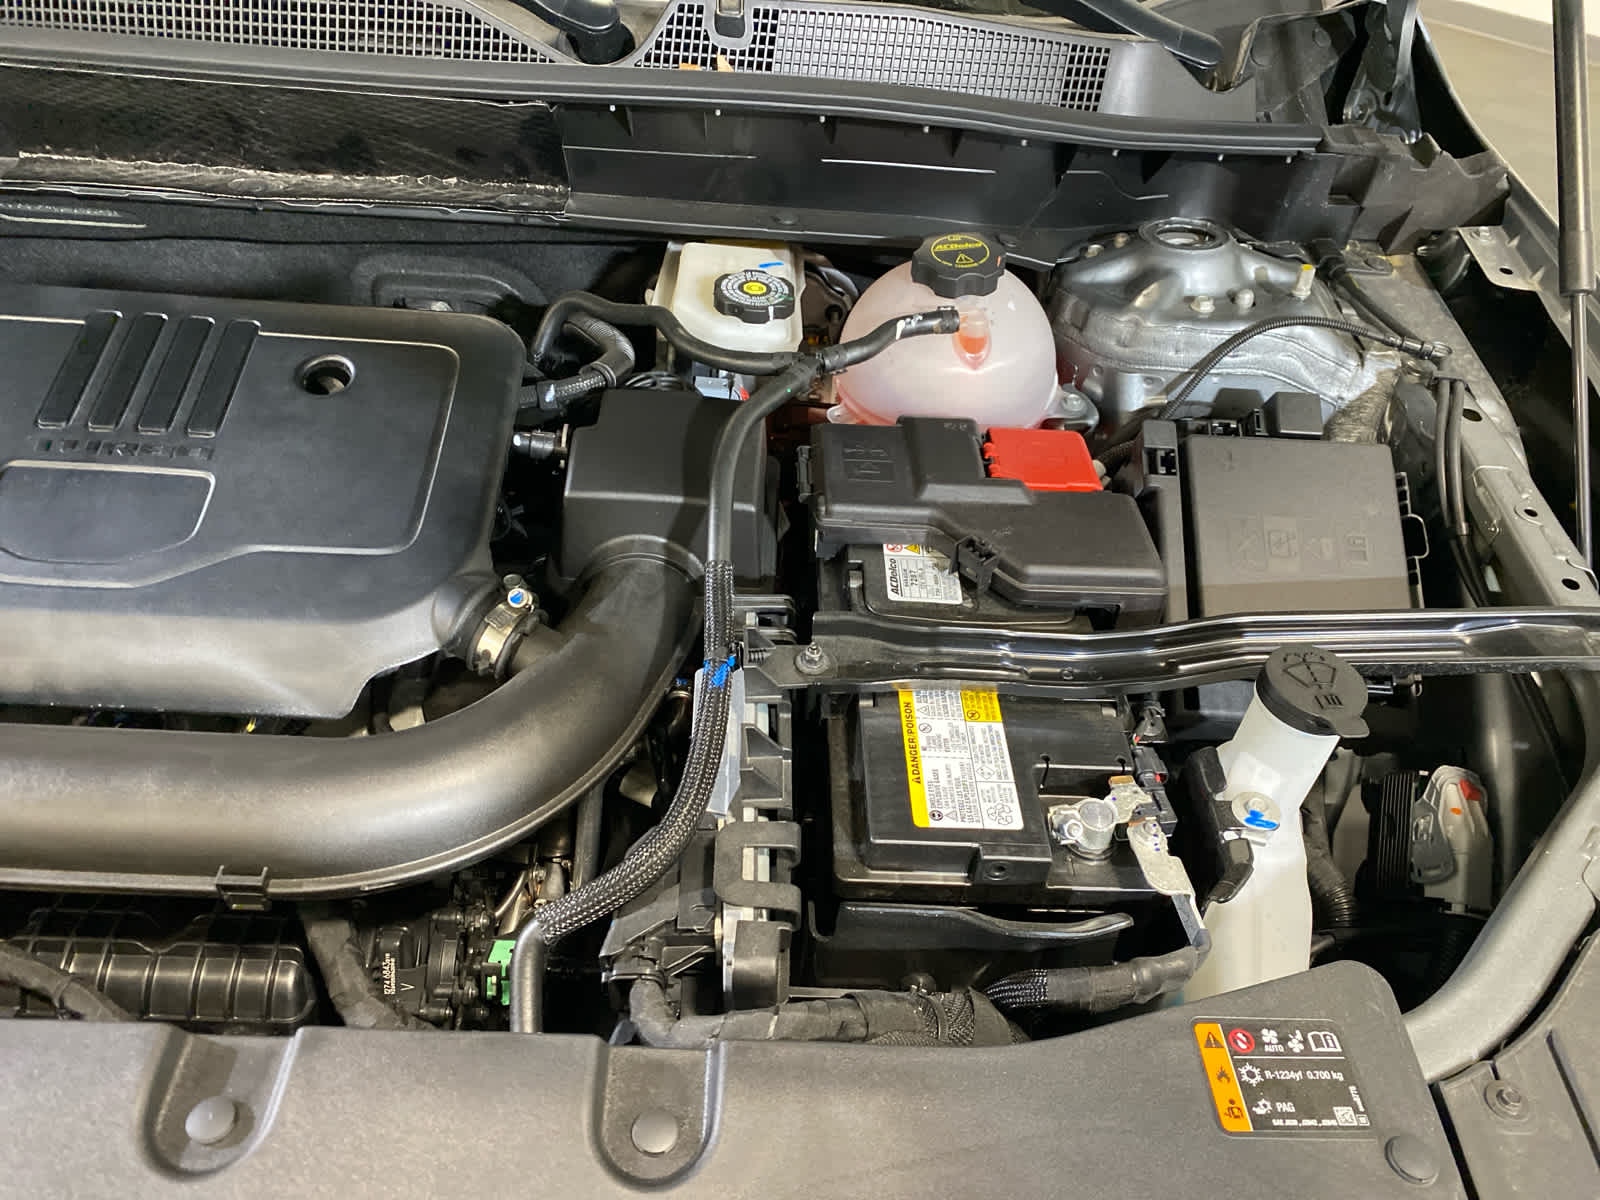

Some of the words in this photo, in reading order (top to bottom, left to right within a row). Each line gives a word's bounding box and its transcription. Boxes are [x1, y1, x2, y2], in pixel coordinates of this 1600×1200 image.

[888, 558, 900, 596] ACDelco
[903, 701, 921, 776] DANGER/POISON
[1264, 1044, 1284, 1052] AUTO
[1306, 1070, 1331, 1080] 0.700
[1331, 1070, 1344, 1081] kg
[1276, 1102, 1296, 1112] PAG
